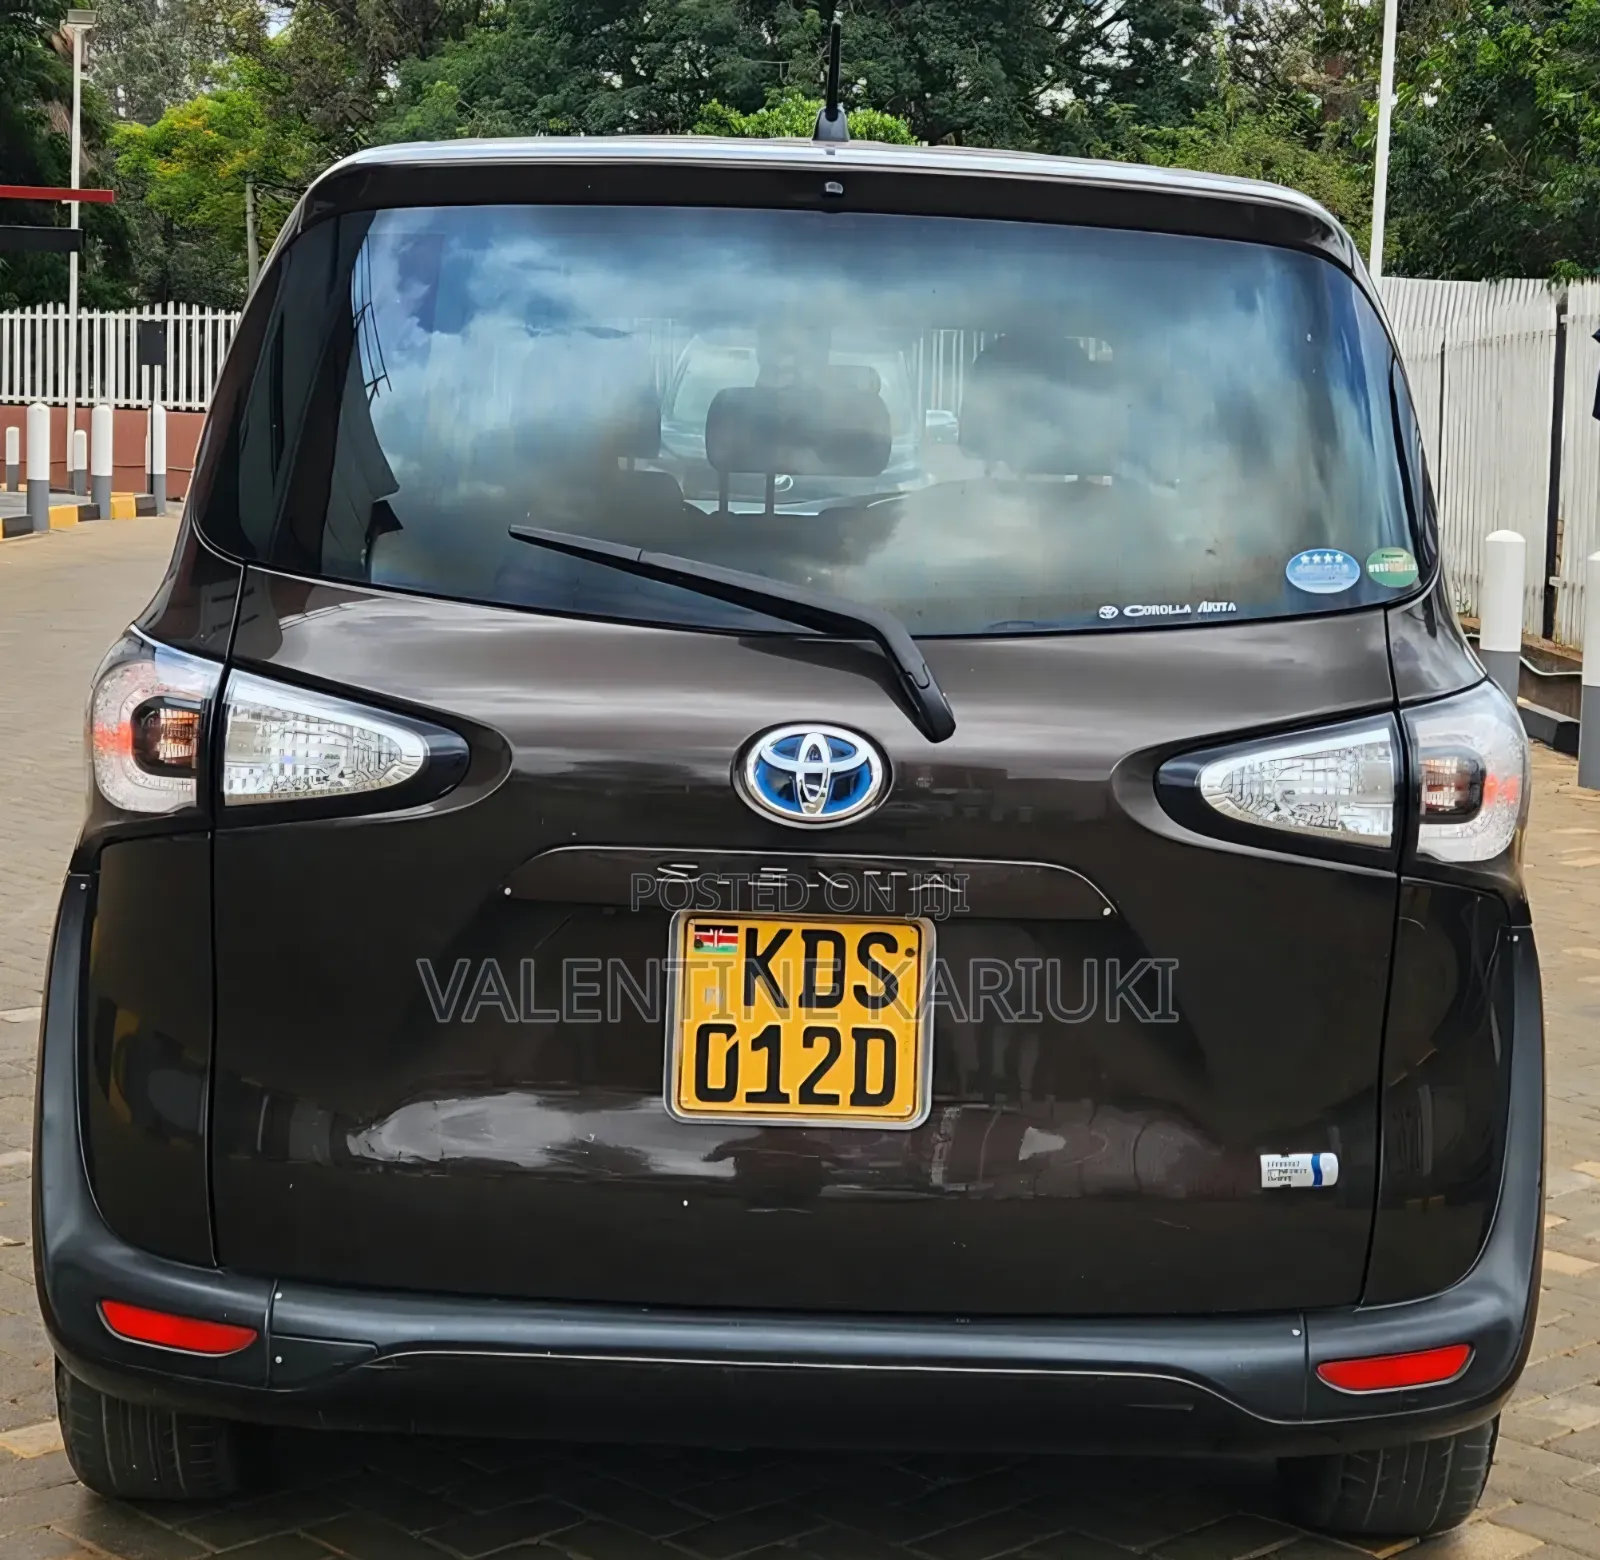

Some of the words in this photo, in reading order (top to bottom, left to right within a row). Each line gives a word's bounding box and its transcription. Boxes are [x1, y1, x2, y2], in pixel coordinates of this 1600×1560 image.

[1123, 604, 1191, 617] COROLLA
[743, 927, 899, 1010] KDS
[694, 1022, 897, 1107] 012D
